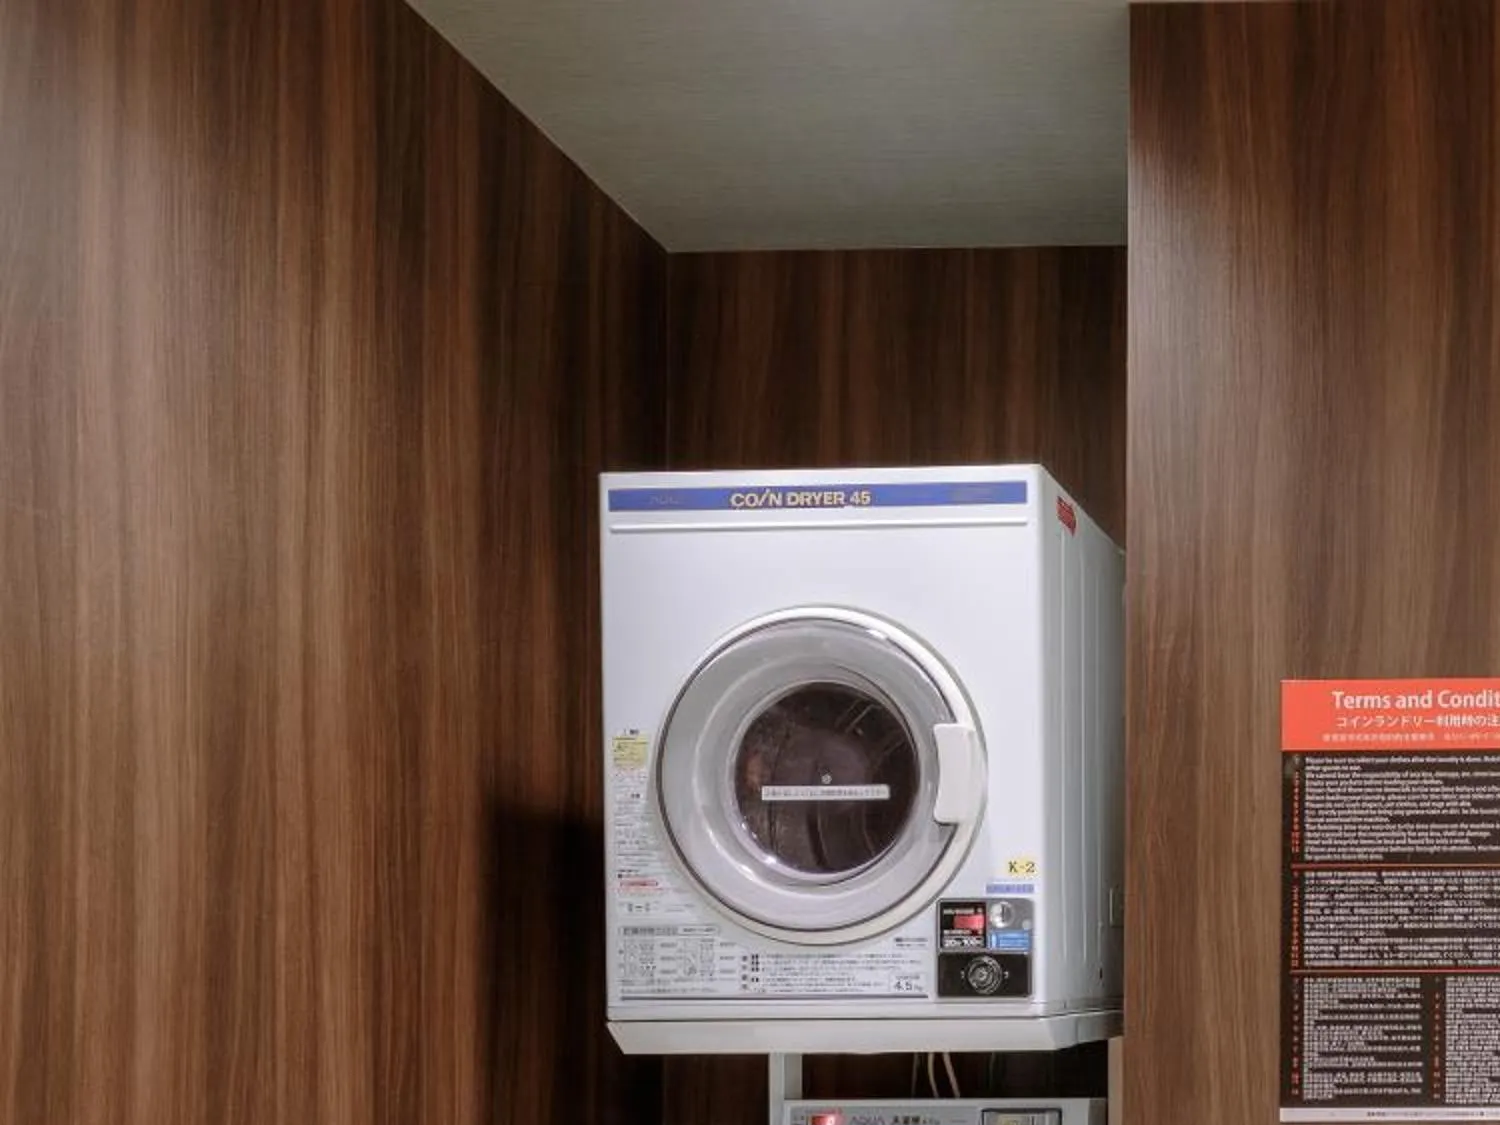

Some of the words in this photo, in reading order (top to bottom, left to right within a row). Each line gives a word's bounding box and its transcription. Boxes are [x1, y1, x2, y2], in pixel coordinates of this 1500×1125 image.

[786, 491, 845, 506] DRYER
[850, 490, 871, 505] 45
[1331, 690, 1390, 709] Terms
[1395, 690, 1433, 708] and
[1008, 861, 1036, 874] K-2
